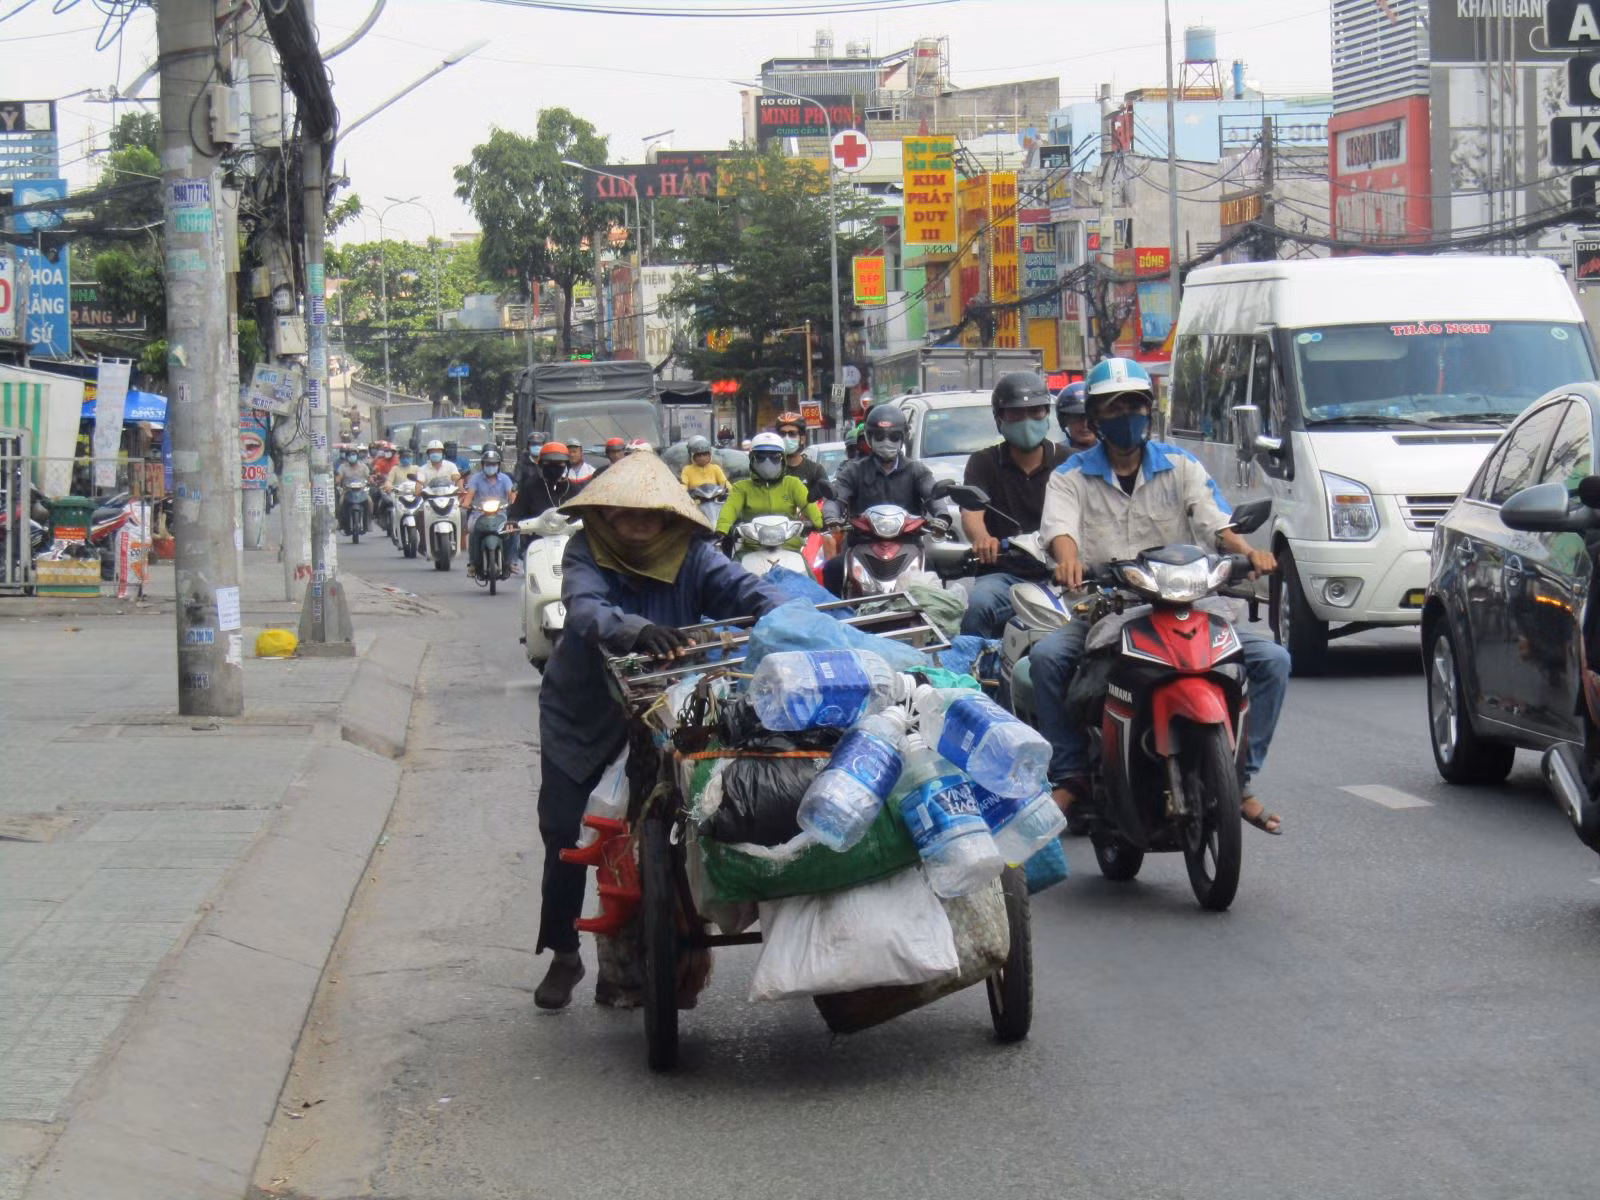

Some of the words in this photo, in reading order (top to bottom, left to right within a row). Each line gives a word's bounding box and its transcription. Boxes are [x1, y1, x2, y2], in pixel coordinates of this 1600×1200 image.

[760, 106, 800, 125] MINH
[646, 165, 711, 197] HÁT
[913, 174, 946, 186] KIM
[906, 188, 953, 204] PHÁT
[913, 210, 947, 223] DUY
[921, 228, 940, 240] III
[30, 268, 64, 285] HOA
[1390, 318, 1442, 335] THẢO
[1108, 682, 1133, 704] YAMAHA
